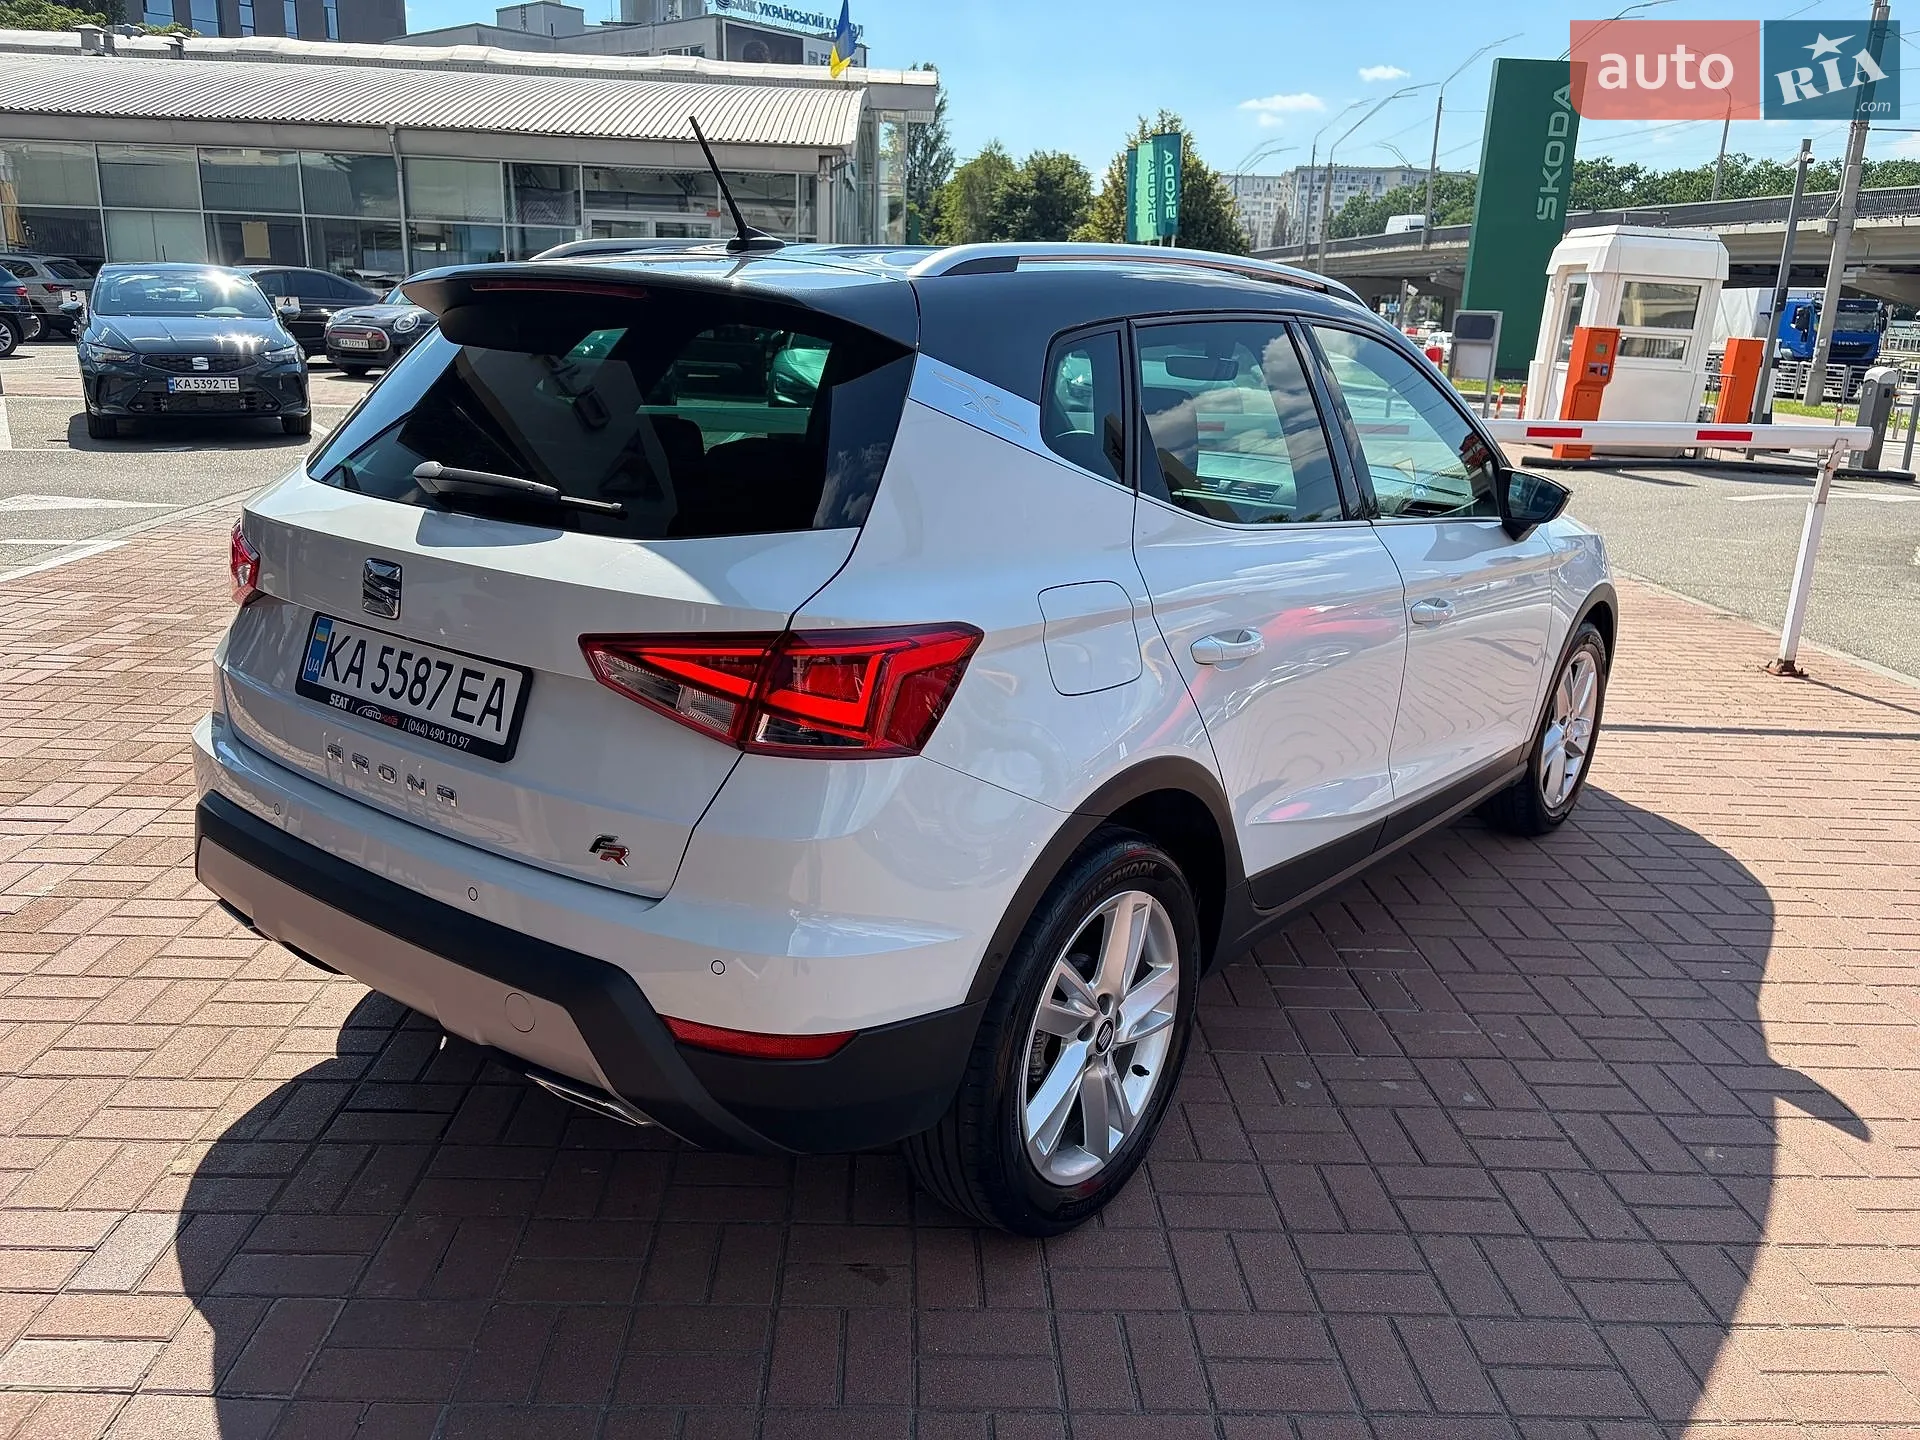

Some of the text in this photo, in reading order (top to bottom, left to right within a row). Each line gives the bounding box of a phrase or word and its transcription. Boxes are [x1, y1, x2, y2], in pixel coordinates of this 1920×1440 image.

[759, 2, 825, 29] УКРАЇНСЬКИЙ
[70, 291, 78, 302] 5
[283, 297, 291, 307] 4
[175, 379, 238, 389] KA 5392 TE
[307, 658, 320, 674] UA
[321, 631, 507, 732] KA 5587 EA
[329, 693, 350, 711] SEAT
[407, 718, 429, 735] (044)
[429, 728, 445, 741] 490
[447, 732, 458, 745] 10
[458, 736, 470, 749] 97
[327, 743, 459, 807] ARONA
[589, 834, 630, 867] FR
